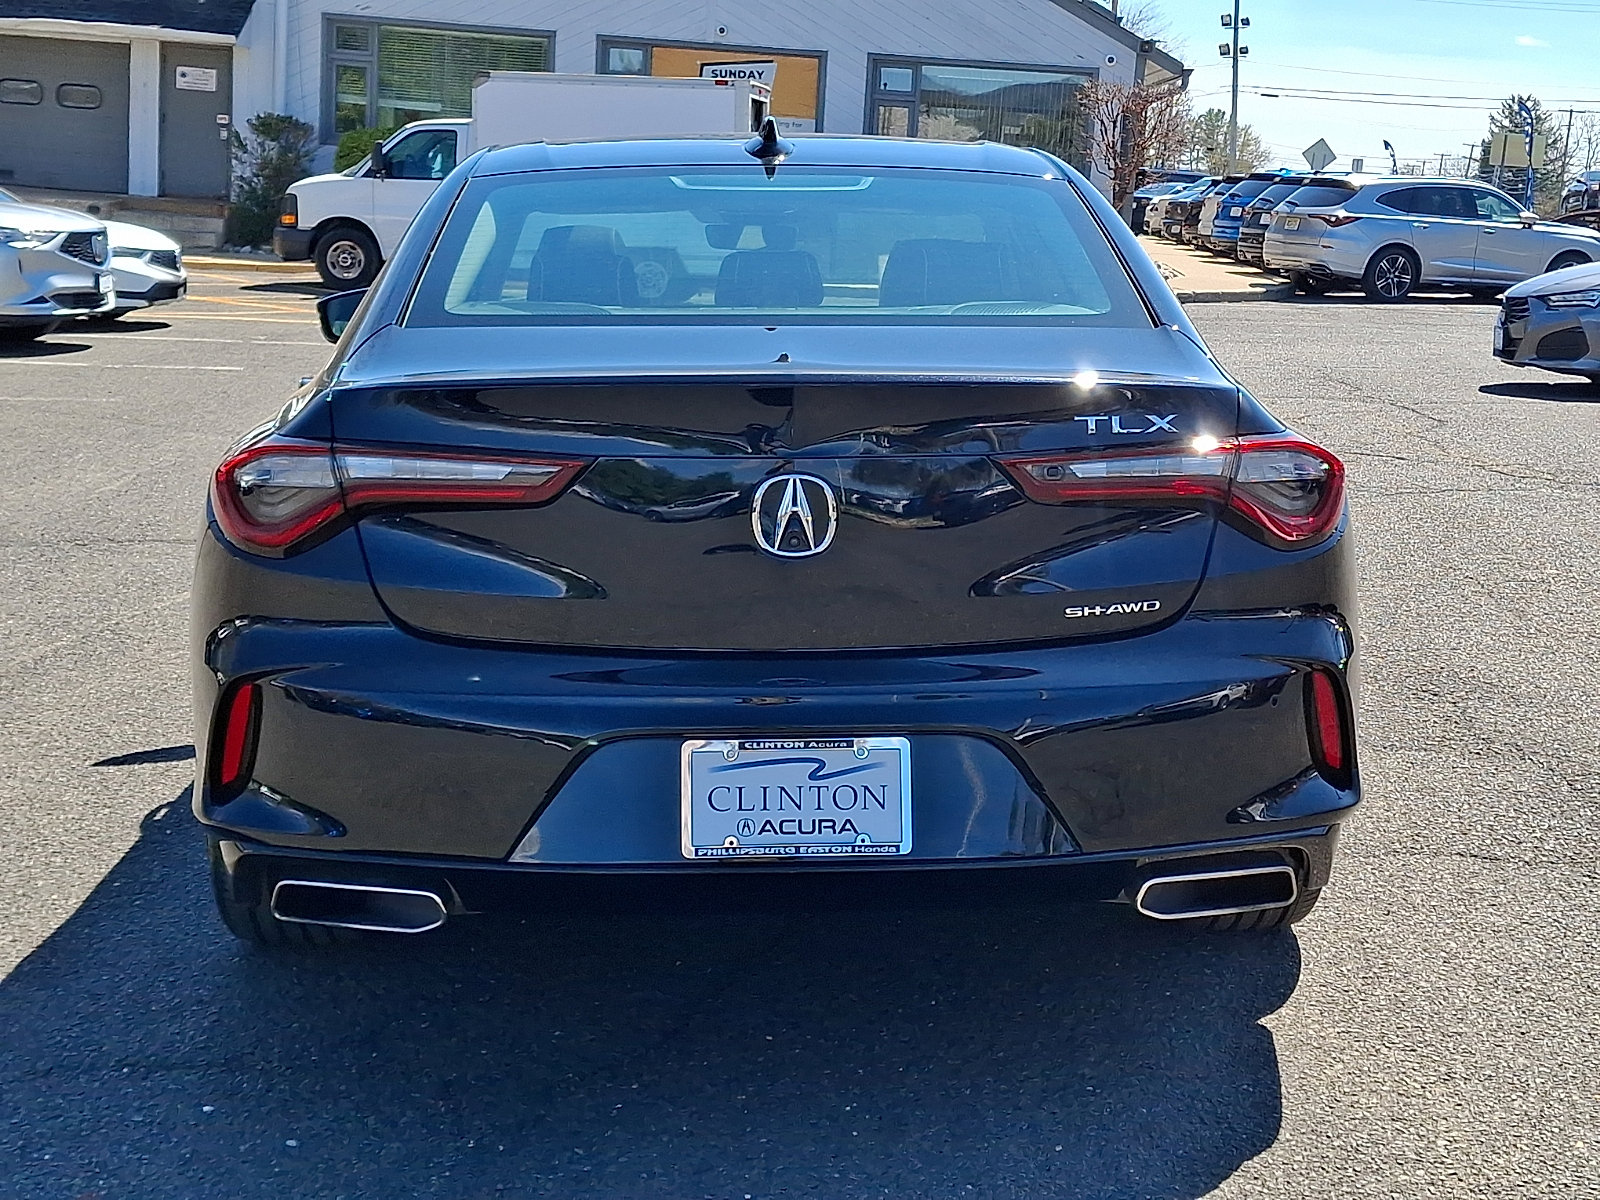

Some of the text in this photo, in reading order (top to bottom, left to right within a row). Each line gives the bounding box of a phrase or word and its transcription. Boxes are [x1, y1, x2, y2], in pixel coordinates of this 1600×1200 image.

[711, 69, 765, 79] SUNDAY
[1074, 414, 1179, 434] TLX
[1064, 600, 1161, 618] SH-AWD
[744, 741, 848, 749] CLINTON Acura
[707, 784, 888, 812] CLINTON
[757, 818, 859, 836] ACURA
[697, 845, 897, 856] PHILLIPSBURG EASTON Honda
